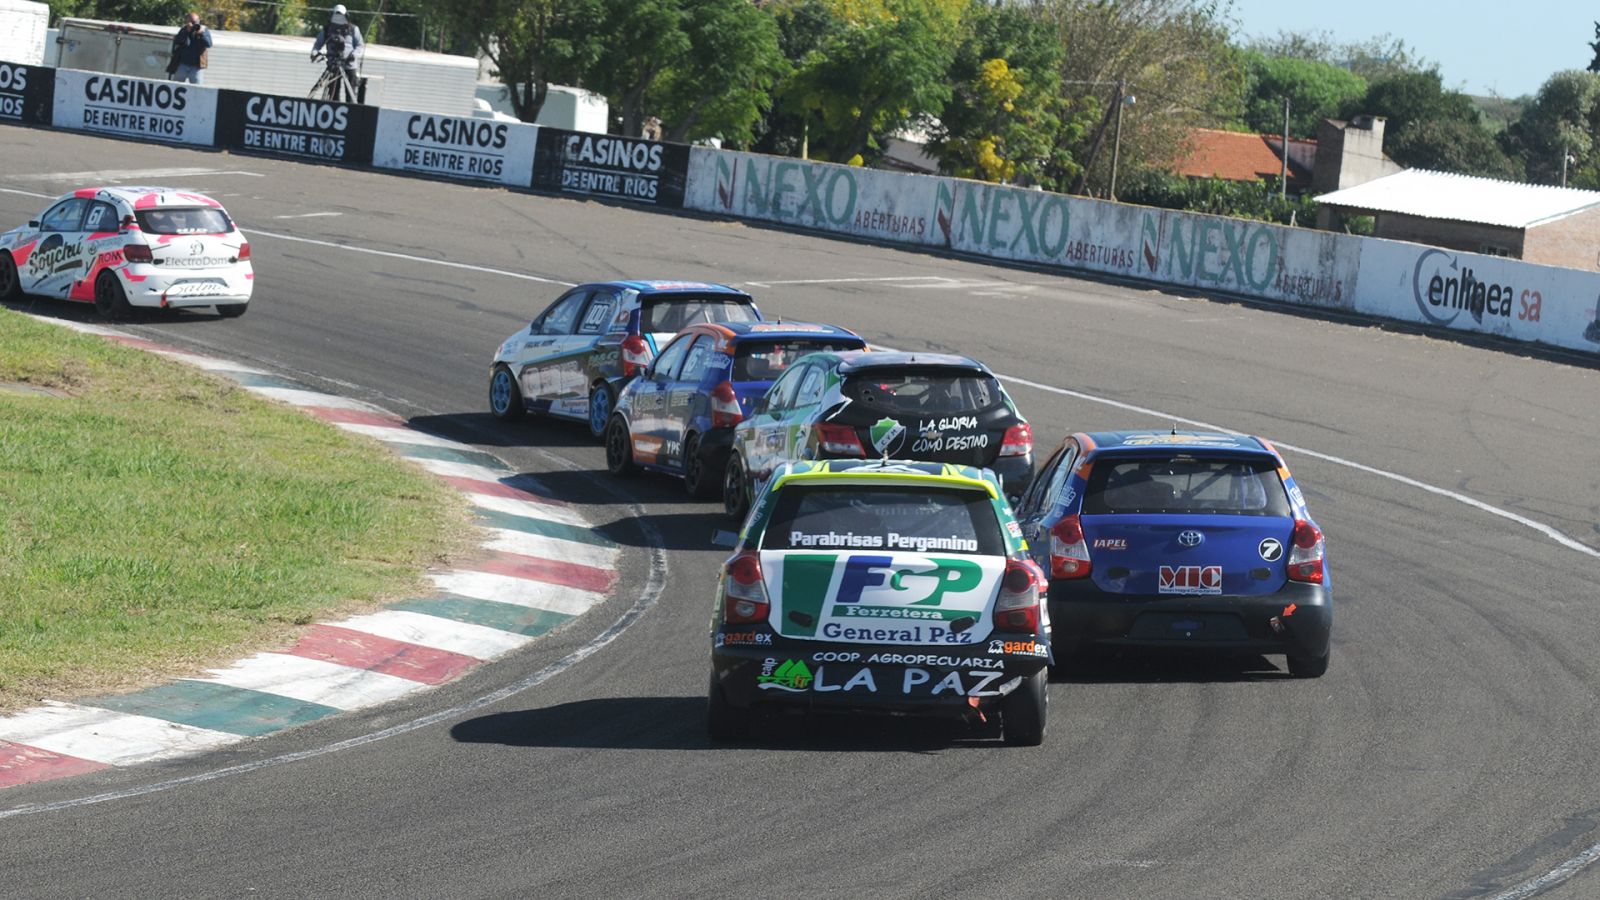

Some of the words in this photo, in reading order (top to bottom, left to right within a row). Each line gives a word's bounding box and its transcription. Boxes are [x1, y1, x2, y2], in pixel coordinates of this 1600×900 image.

[85, 77, 187, 110] CASINOS
[84, 109, 99, 125] DE
[102, 111, 145, 131] ENTRE
[149, 116, 184, 136] RIOS
[246, 95, 349, 131] CASINOS
[244, 129, 261, 146] DE
[264, 131, 306, 152] ENTRE
[310, 136, 345, 158] RIOS
[407, 115, 508, 149] CASINOS
[404, 148, 420, 165] DE
[423, 151, 464, 171] ENTRE
[468, 156, 504, 177] RIOS
[564, 135, 663, 171] CASINOS
[562, 169, 579, 187] DE
[624, 178, 658, 198] RIOS
[743, 157, 858, 226] NEXO
[855, 208, 925, 236] ABERTURAS
[959, 184, 1070, 258] NEXO
[165, 256, 228, 266] ElectroDom
[1066, 241, 1134, 268] ABERTURAS
[1167, 217, 1278, 291] NEXO
[586, 304, 609, 324] 100
[1518, 288, 1542, 322] sa
[919, 419, 936, 432] LA
[938, 416, 978, 431] GLORIA
[912, 438, 943, 453] COMO
[945, 434, 988, 451] DESTINO
[790, 531, 883, 547] Parabrisas
[887, 532, 978, 551] Pergamino
[1263, 542, 1279, 558] 7
[1160, 566, 1222, 588] MIC
[846, 606, 943, 620] Ferretera
[725, 630, 772, 645] gardex
[823, 622, 922, 643] General
[929, 627, 972, 644] Paz
[868, 653, 1004, 668] AGROPECUARIA
[1004, 640, 1048, 654] gardex
[813, 666, 877, 692] LA
[903, 668, 1004, 696] PAZ
